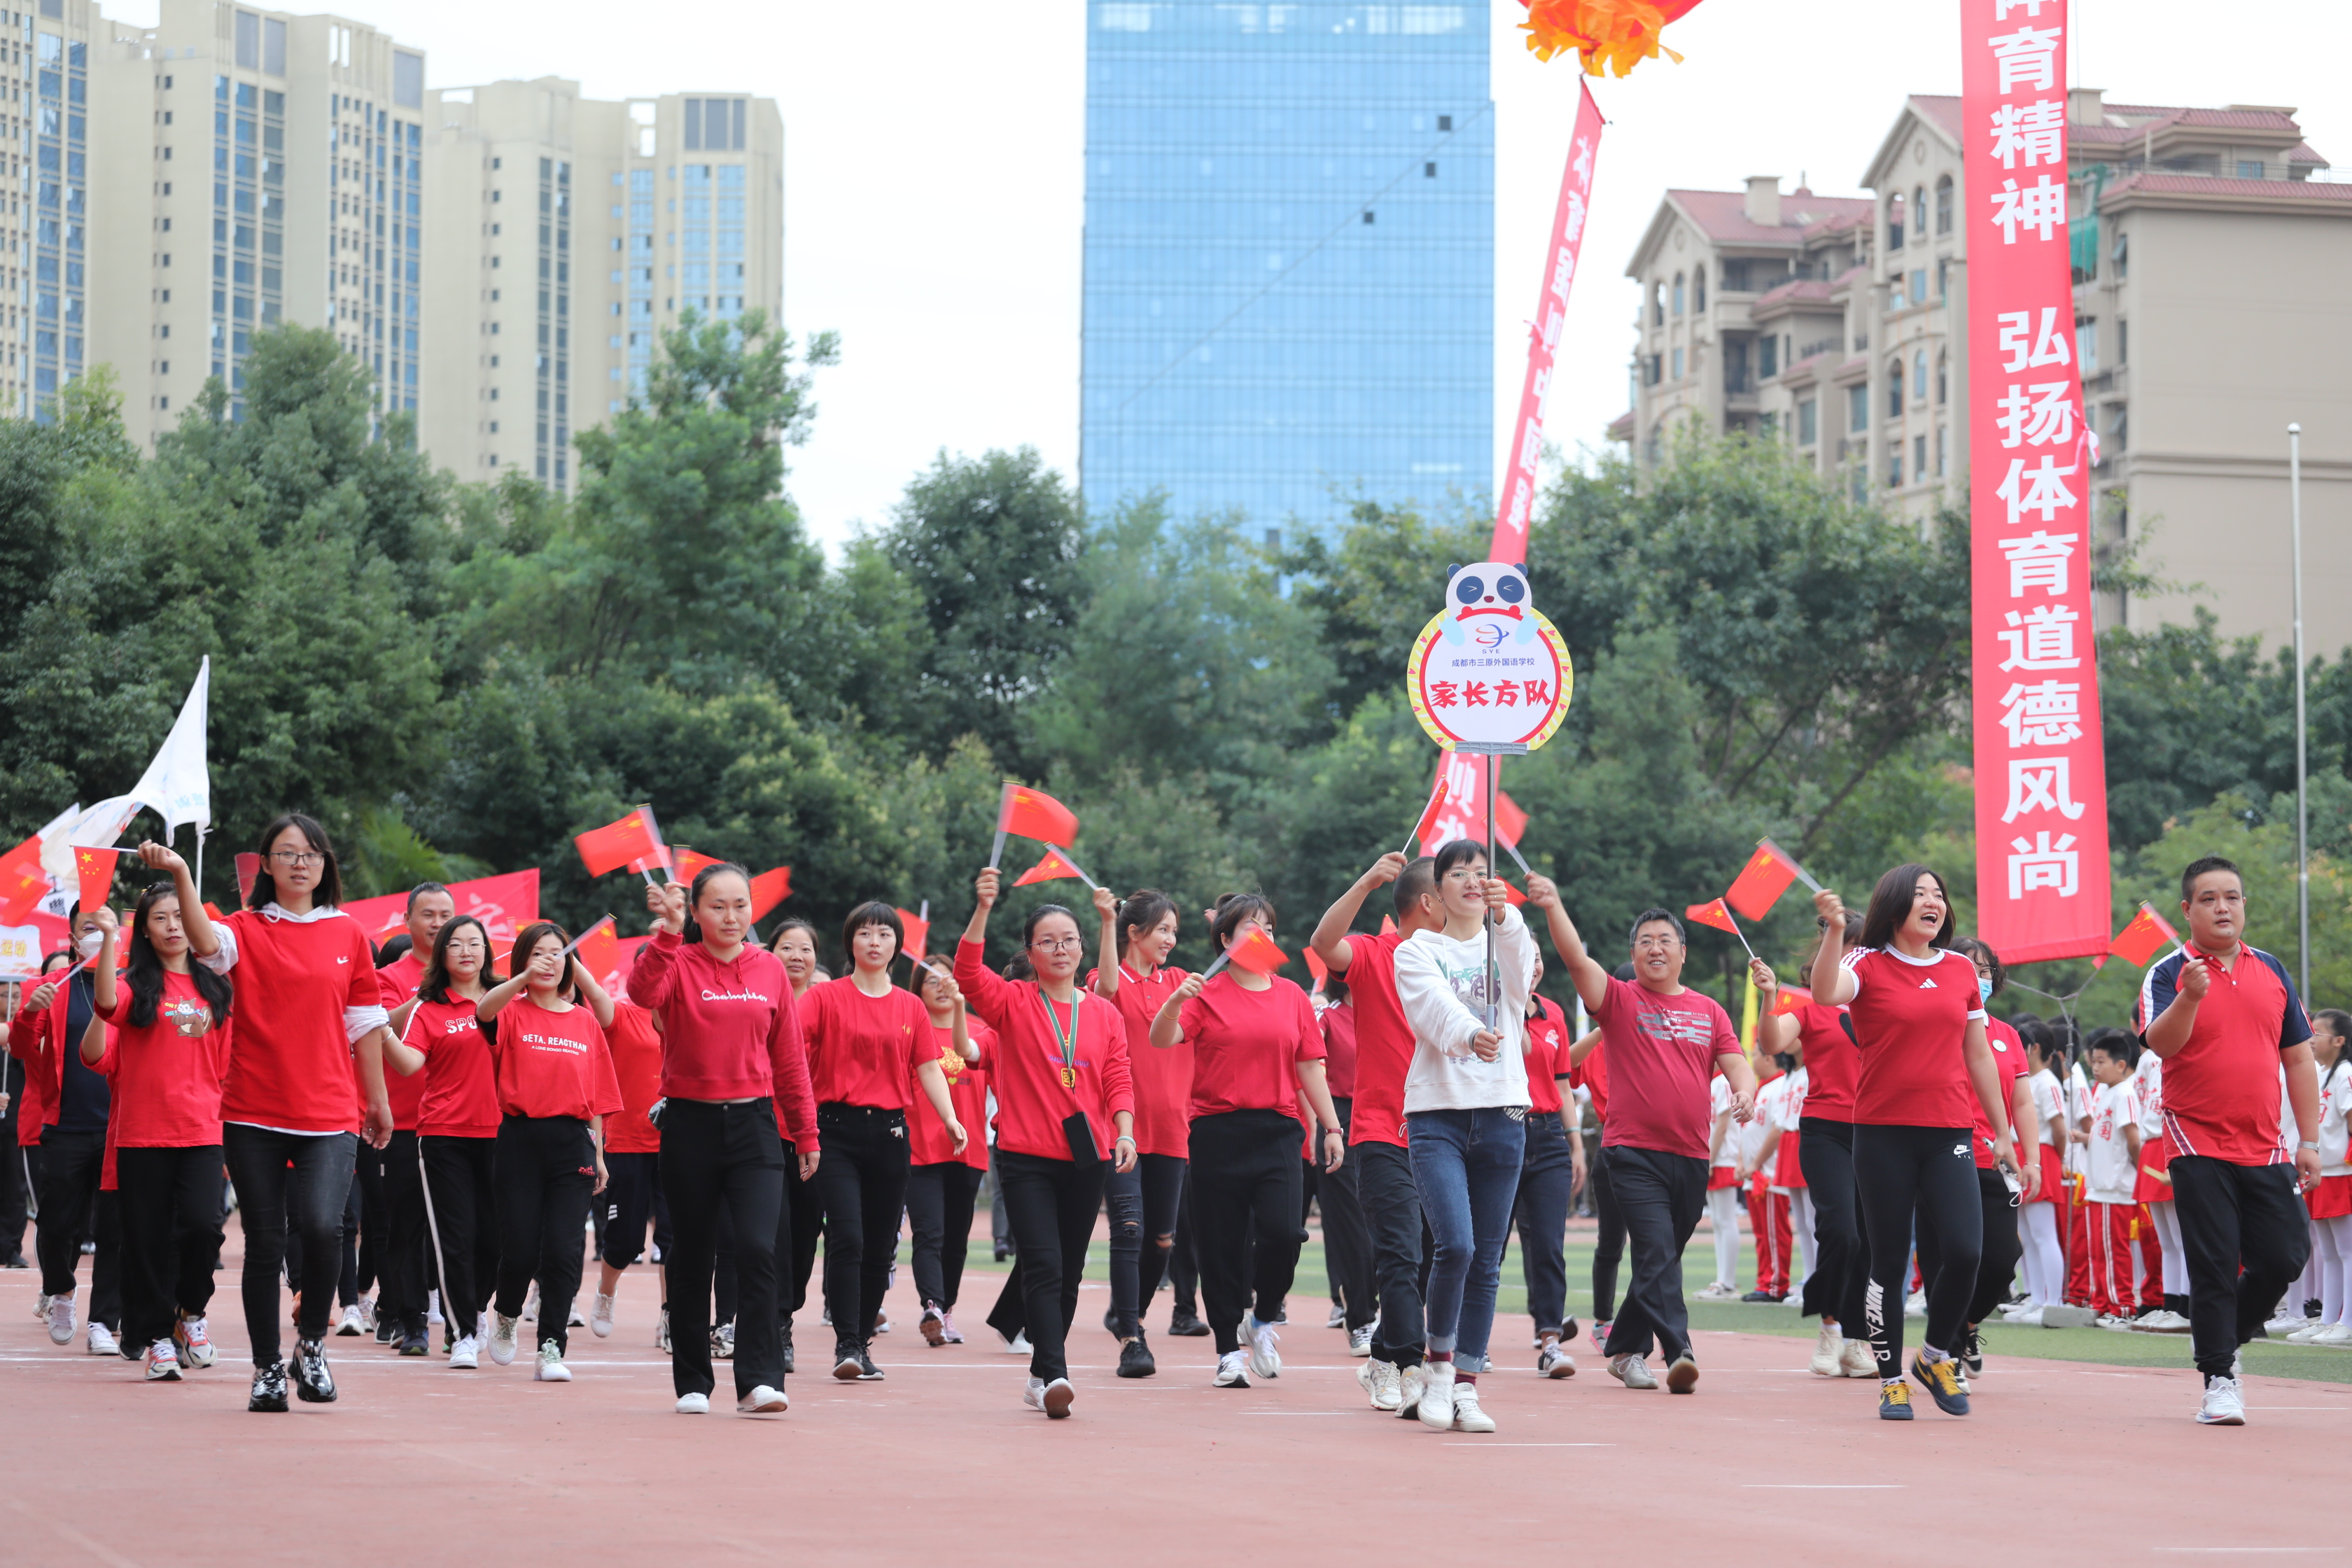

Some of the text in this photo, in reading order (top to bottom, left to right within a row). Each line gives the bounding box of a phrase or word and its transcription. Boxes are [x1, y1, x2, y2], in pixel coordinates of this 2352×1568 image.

[1987, 0, 2085, 900] 育精神 弘扬体育道德风尚
[1452, 657, 1535, 667] 成都市三原外国语学校
[1429, 678, 1552, 709] 家长方队
[522, 1034, 587, 1052] SETA. REACTHAN
[1865, 1278, 1891, 1361] NIKE AIR
